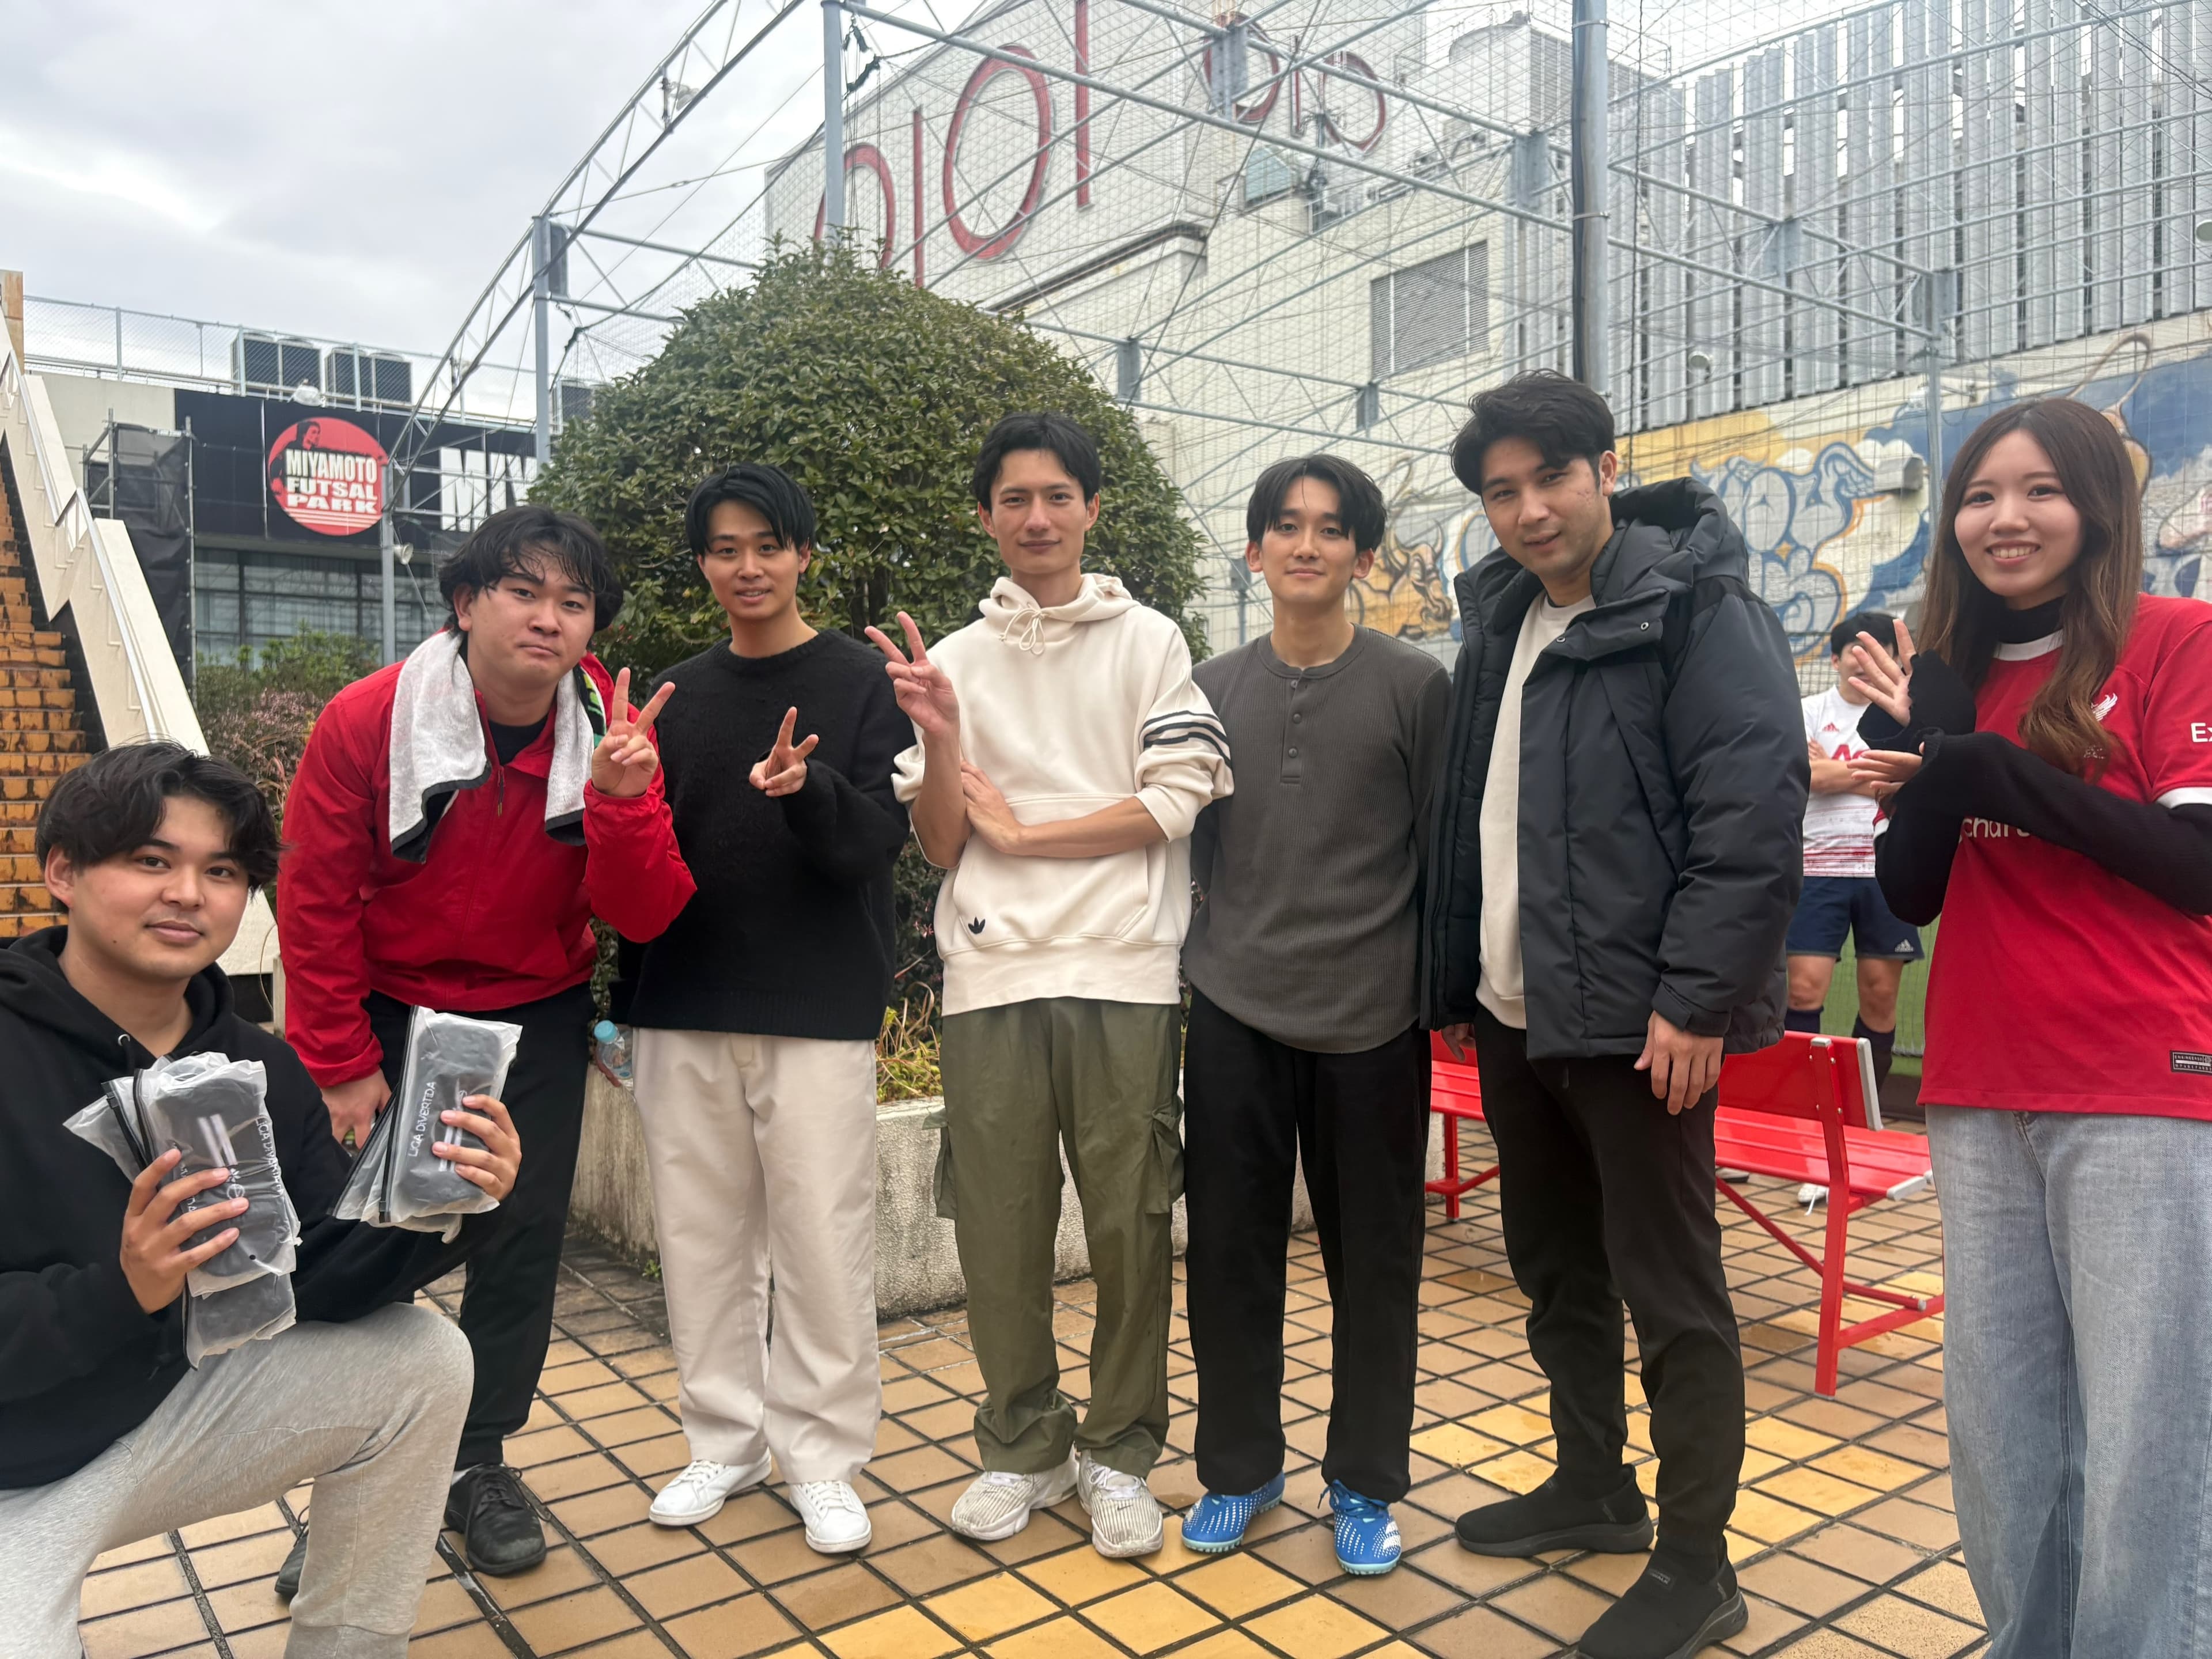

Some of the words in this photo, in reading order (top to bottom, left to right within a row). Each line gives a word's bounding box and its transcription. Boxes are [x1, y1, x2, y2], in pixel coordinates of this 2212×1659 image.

[286, 448, 378, 484] MIYAMOTO
[286, 476, 378, 501] FUTSAL
[287, 493, 378, 514] PARK
